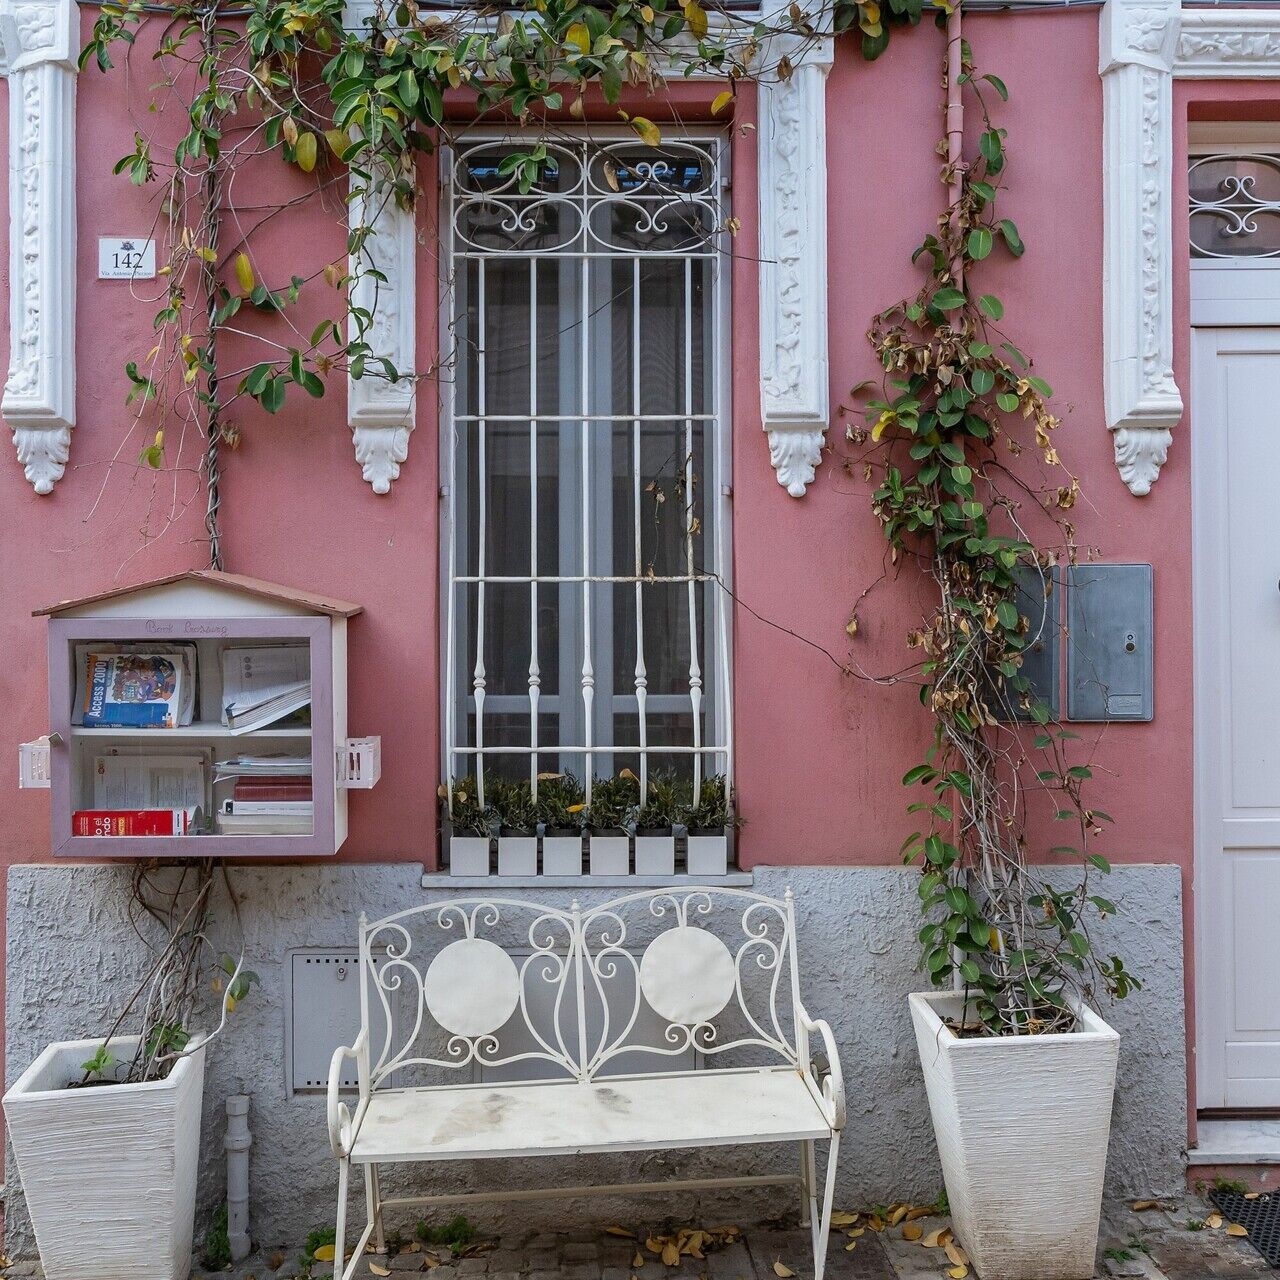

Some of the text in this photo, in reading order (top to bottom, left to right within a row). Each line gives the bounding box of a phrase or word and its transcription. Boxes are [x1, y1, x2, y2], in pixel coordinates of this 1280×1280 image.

[112, 252, 143, 269] 142
[88, 660, 108, 718] Access 2000
[93, 817, 102, 826] el
[102, 817, 111, 836] ndo
